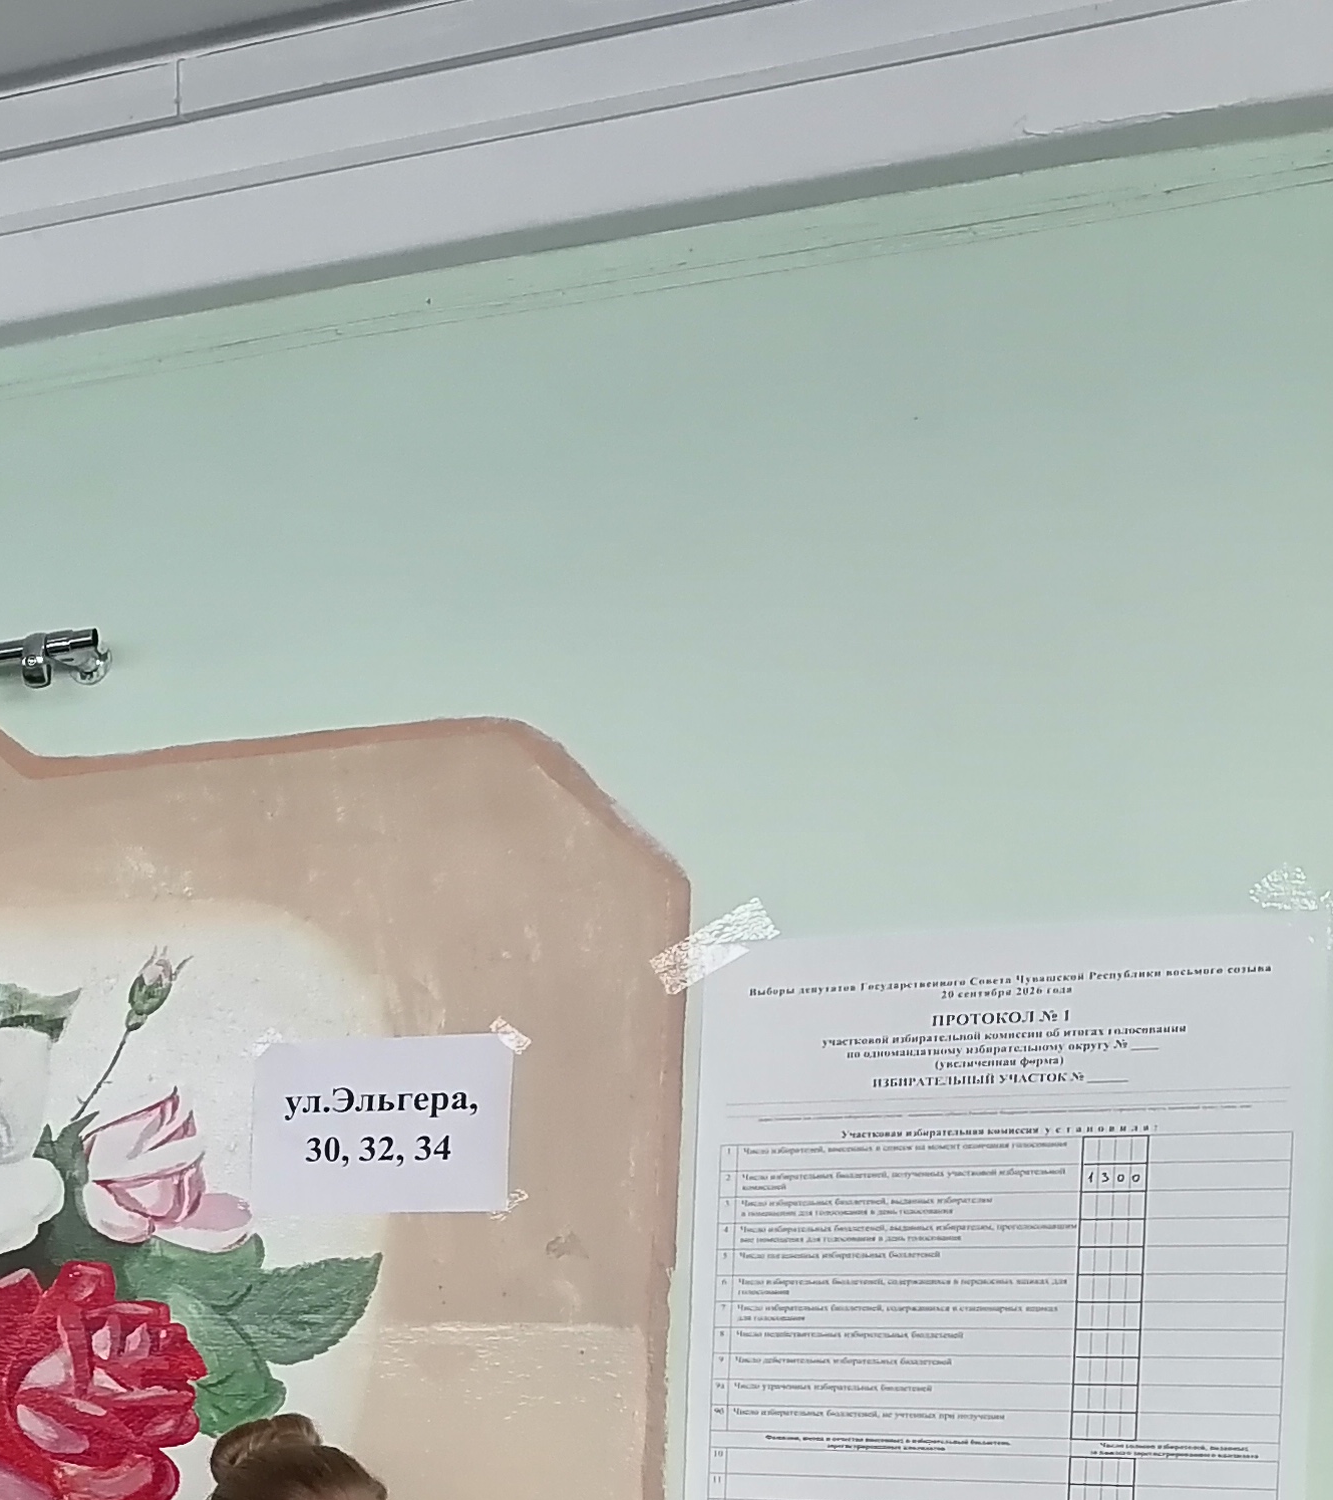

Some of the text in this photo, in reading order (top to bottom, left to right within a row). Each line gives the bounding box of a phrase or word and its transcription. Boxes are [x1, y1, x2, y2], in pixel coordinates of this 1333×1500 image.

[749, 964, 1272, 998] Выборы депутатов Государственного Совета Чувашской Республики восьмого созыва
[941, 986, 1073, 999] 20 сентября 2026 года
[932, 1009, 1070, 1027] ПРОТОКОЛ № 1
[821, 1024, 1187, 1048] участковой избирательной комиссии об итогах голосования
[846, 1050, 861, 1059] по
[863, 1046, 962, 1060] одномандатному
[965, 1042, 1064, 1056] избирательному
[1068, 1041, 1110, 1053] округу
[934, 1056, 1065, 1071] (увеличенная форма)
[872, 1074, 995, 1089] ИЗБИРАТЕЛЬНЫЙ
[998, 1072, 1068, 1086] УЧАСТОК
[284, 1086, 479, 1121] ул.Эльгера,
[841, 1128, 903, 1140] Участковая
[905, 1127, 985, 1140] избирательная
[987, 1127, 1039, 1136] комиссия
[304, 1134, 452, 1167] 30, 32, 34
